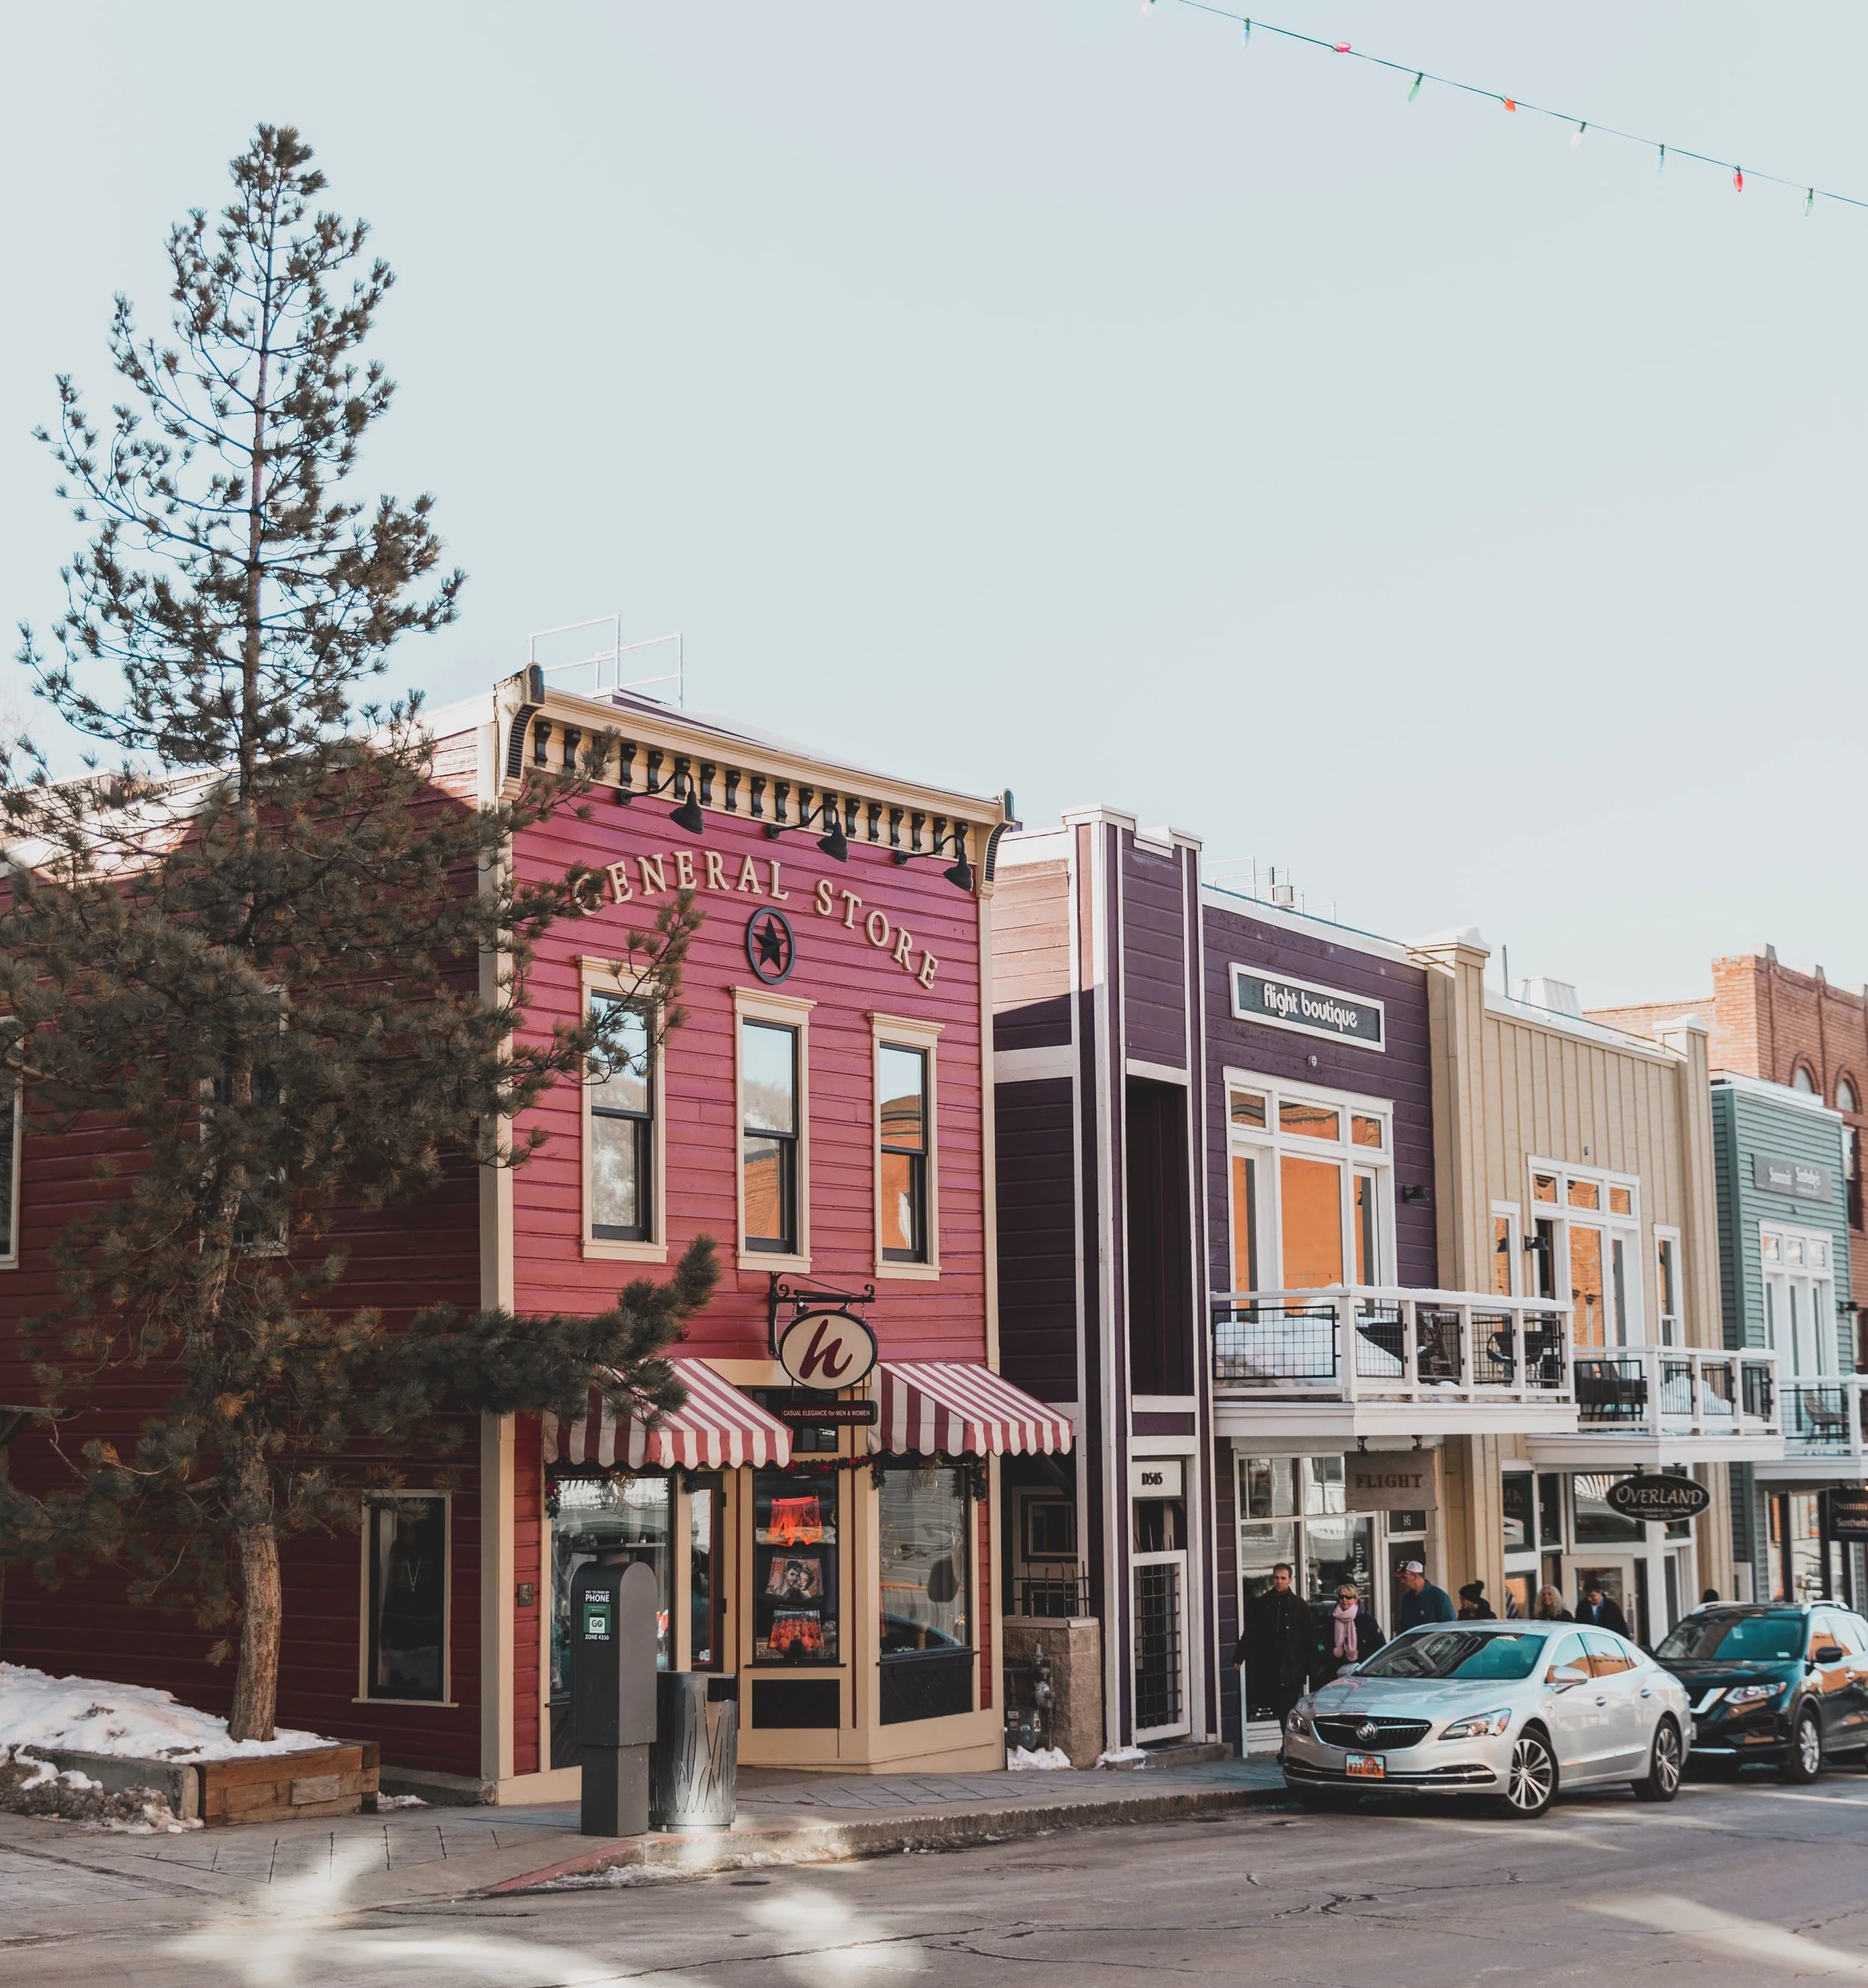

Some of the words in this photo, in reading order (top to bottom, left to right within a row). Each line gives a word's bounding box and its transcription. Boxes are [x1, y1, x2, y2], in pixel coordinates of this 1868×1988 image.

[572, 851, 789, 916] GENERAL
[815, 879, 939, 990] STORE
[1264, 983, 1299, 1017] flight
[1301, 992, 1358, 1031] boutique
[799, 1318, 853, 1379] h
[1355, 1473, 1423, 1488] FLIGHT
[1616, 1485, 1703, 1504] OVERLAND
[585, 1594, 610, 1602] PHONE
